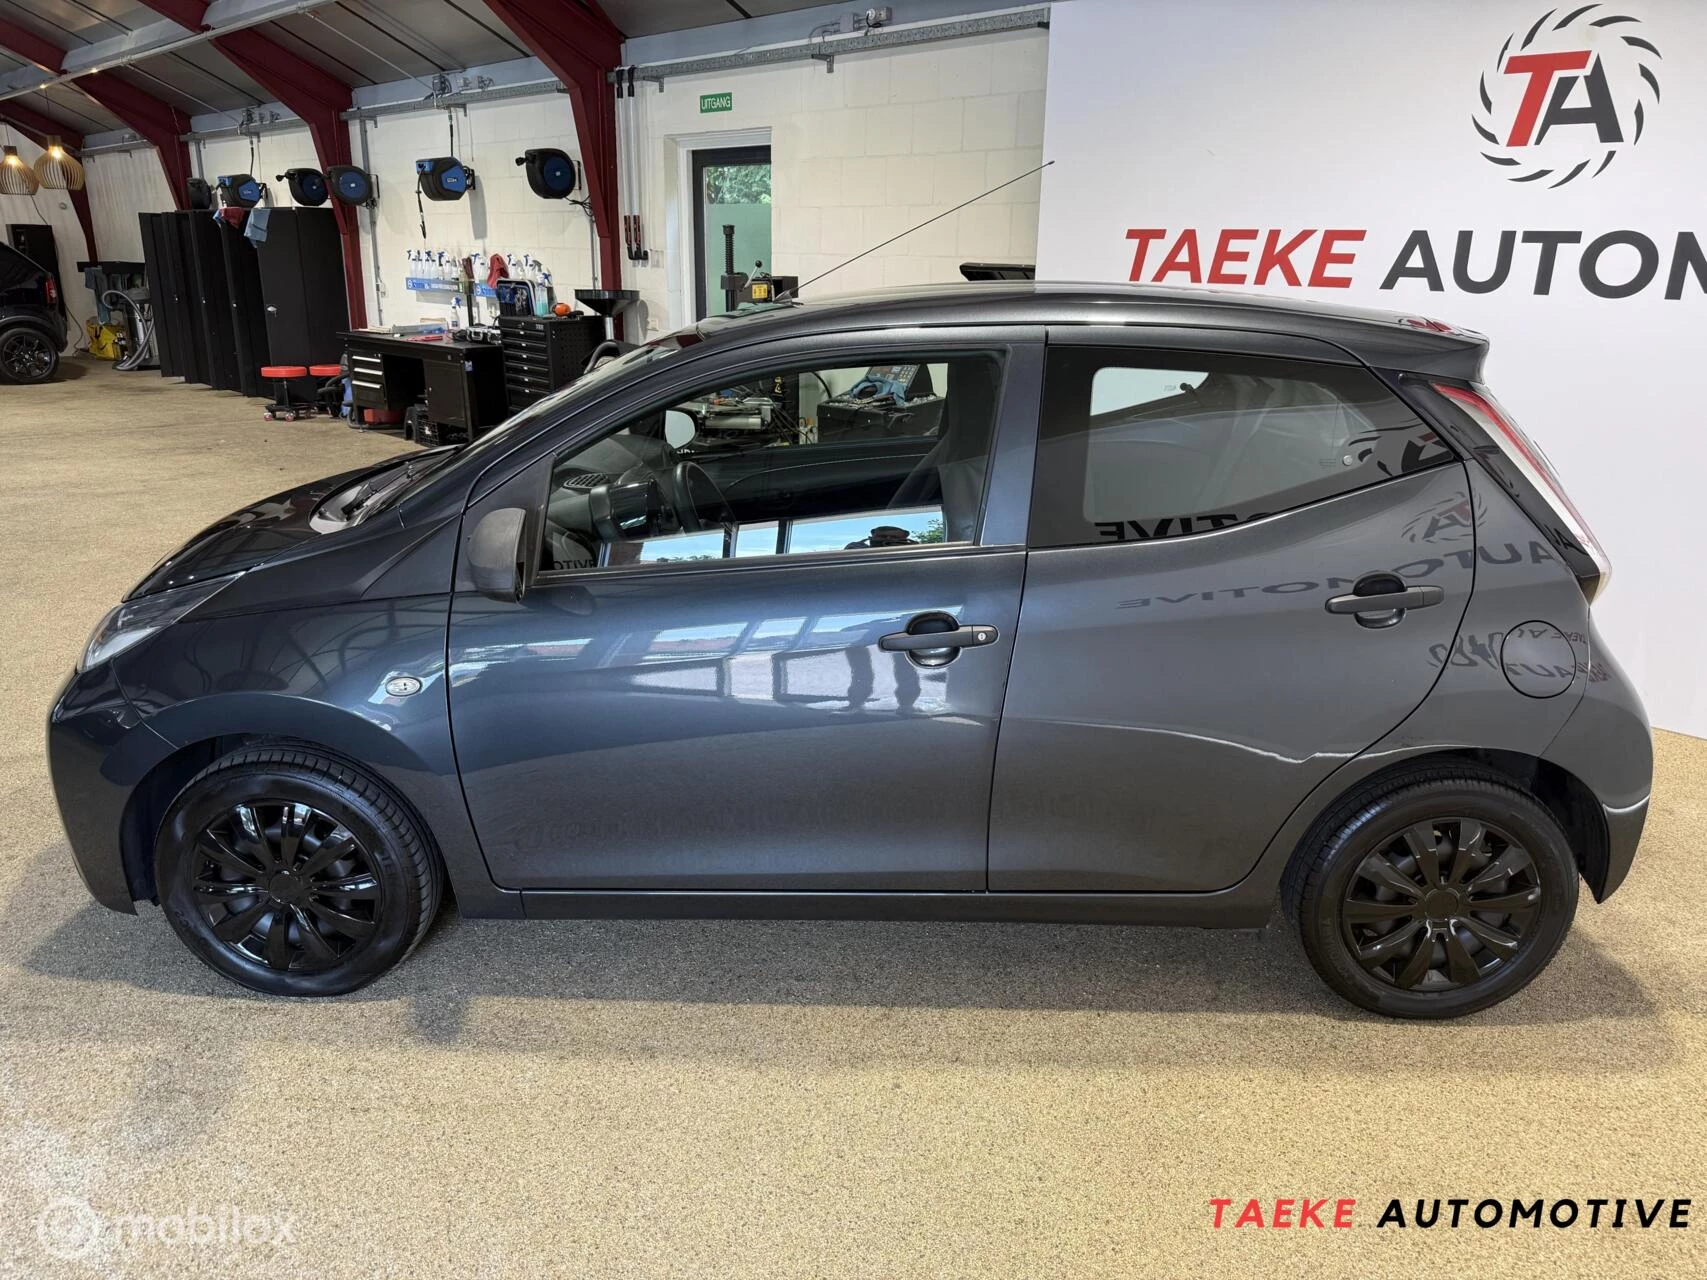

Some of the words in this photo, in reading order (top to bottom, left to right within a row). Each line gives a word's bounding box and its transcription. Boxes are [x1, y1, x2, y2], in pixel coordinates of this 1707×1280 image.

[701, 96, 731, 110] UITGANG
[1504, 50, 1625, 148] TA
[1126, 229, 1367, 288] TAEKE
